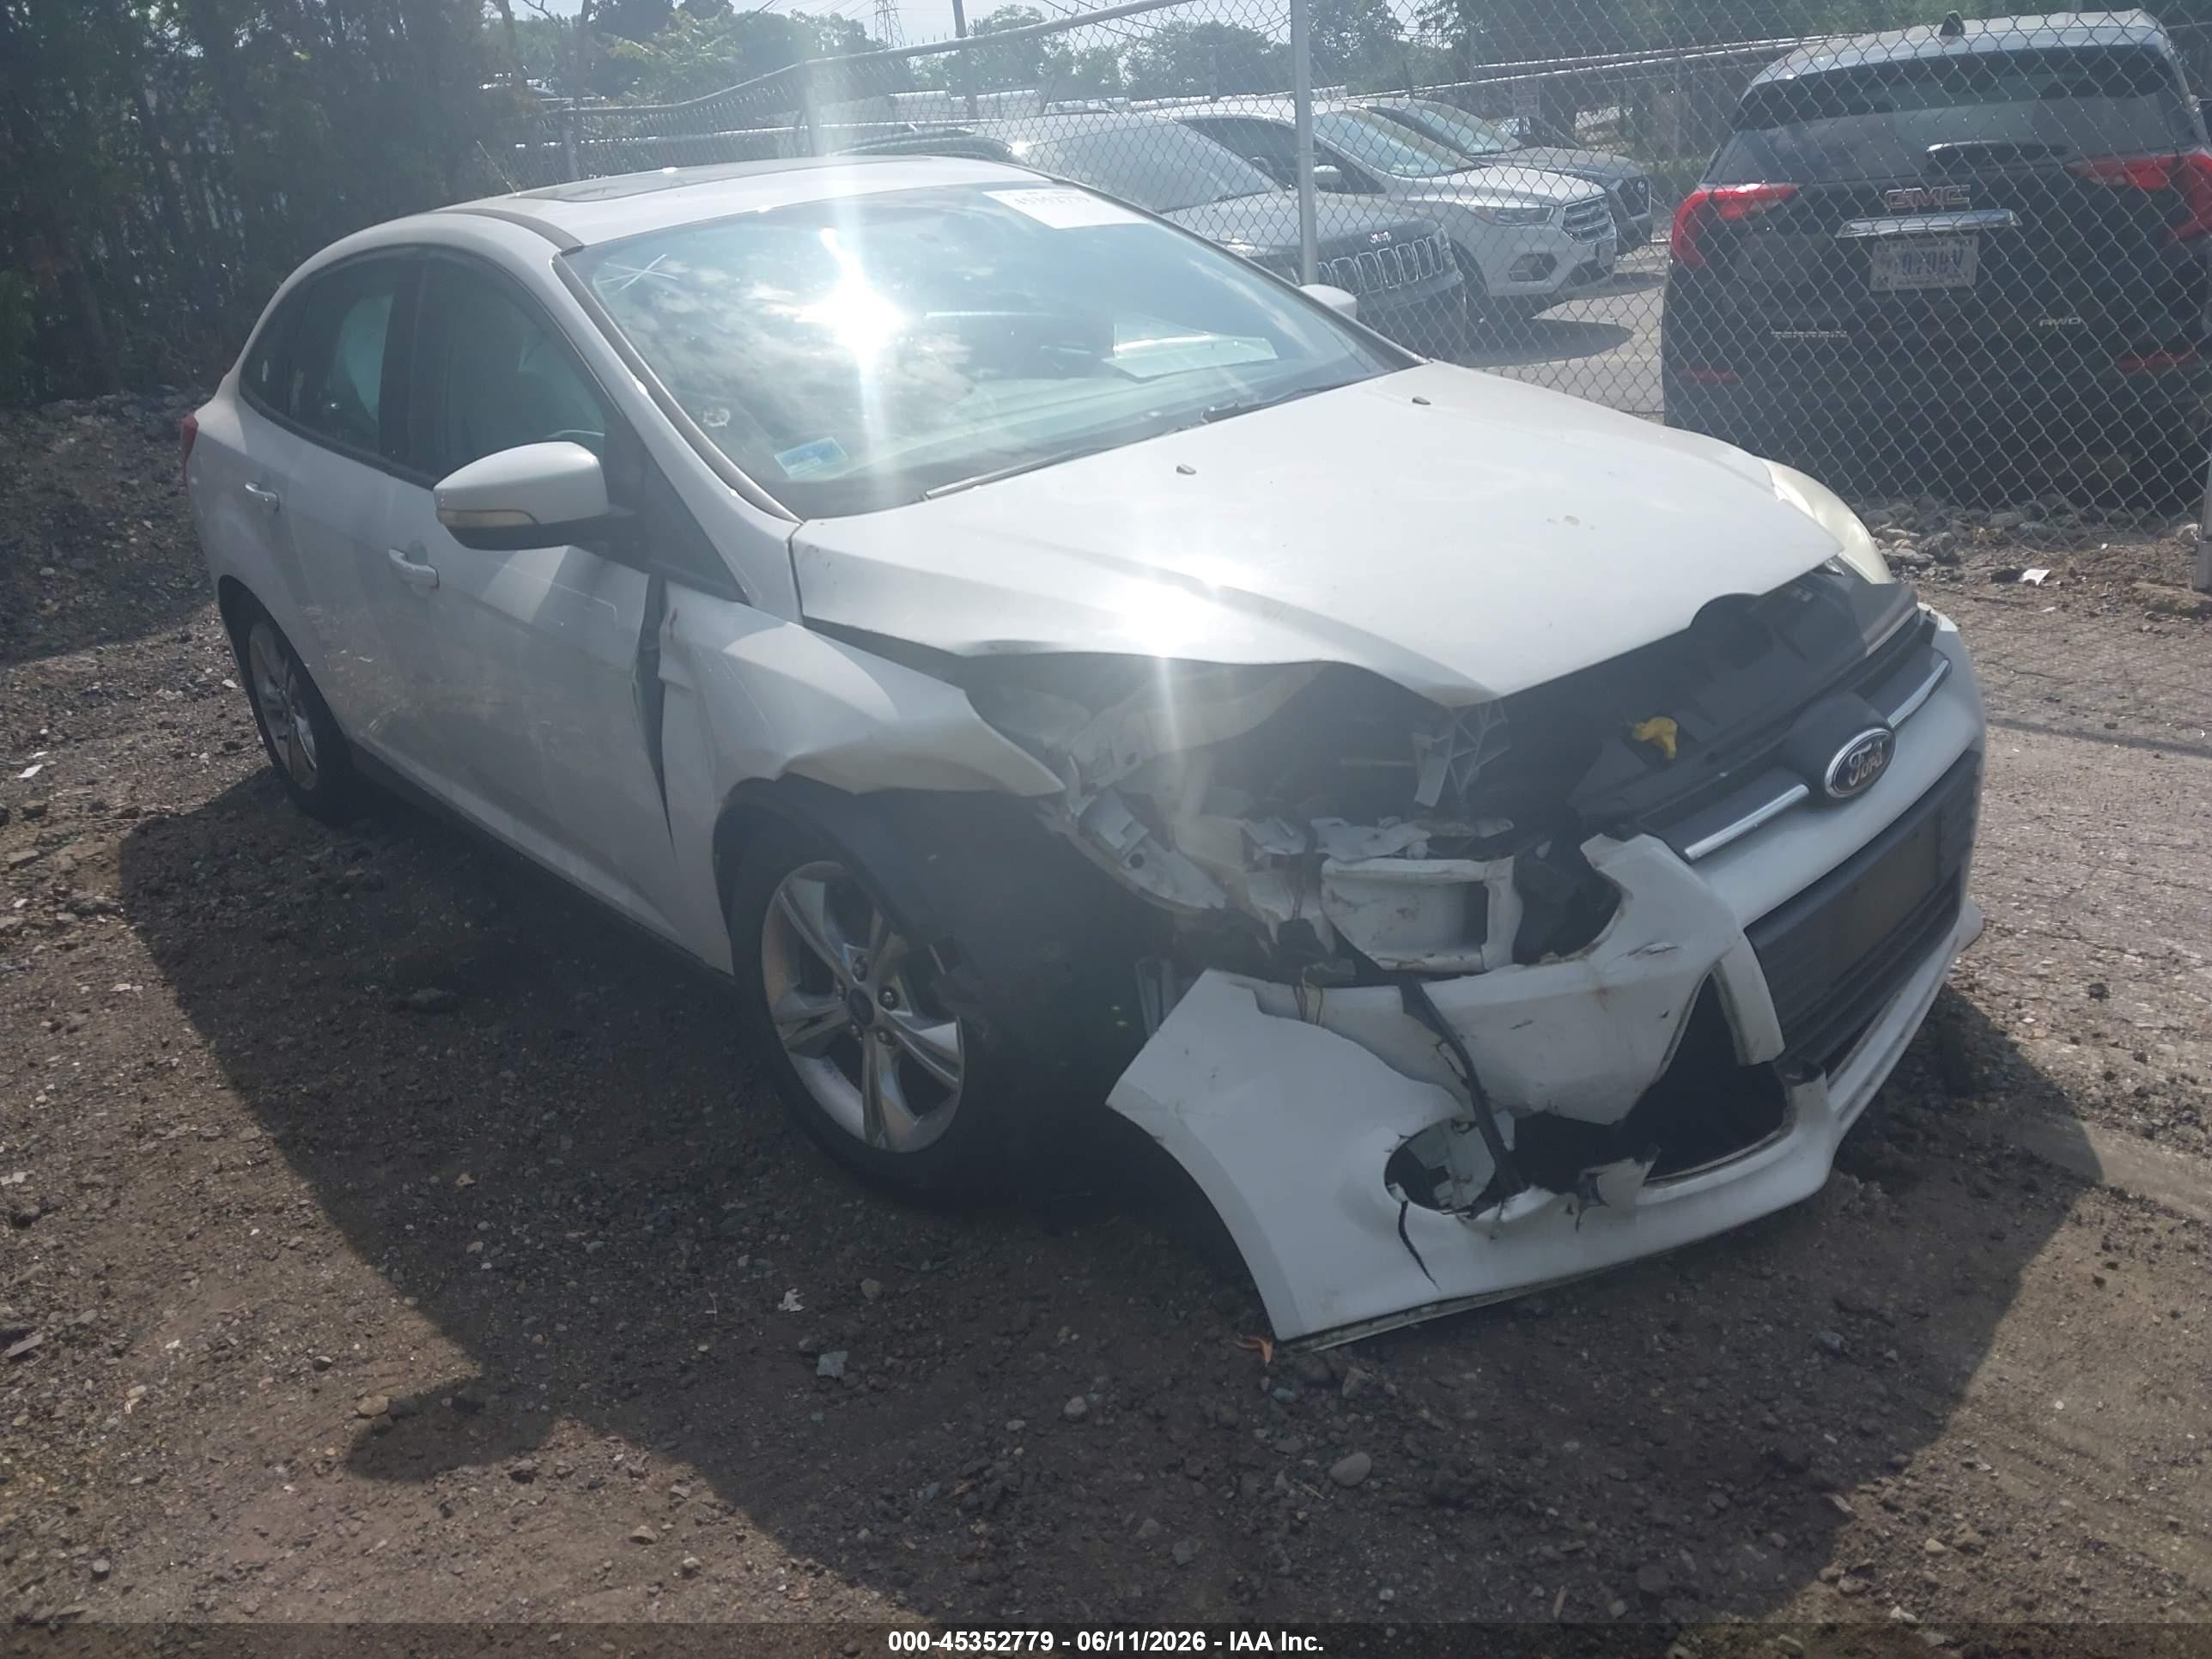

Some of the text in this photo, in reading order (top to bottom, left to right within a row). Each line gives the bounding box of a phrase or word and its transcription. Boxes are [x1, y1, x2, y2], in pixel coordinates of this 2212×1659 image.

[1884, 184, 1972, 210] GMC
[2039, 316, 2081, 327] AWD
[1848, 740, 1883, 787] Ford
